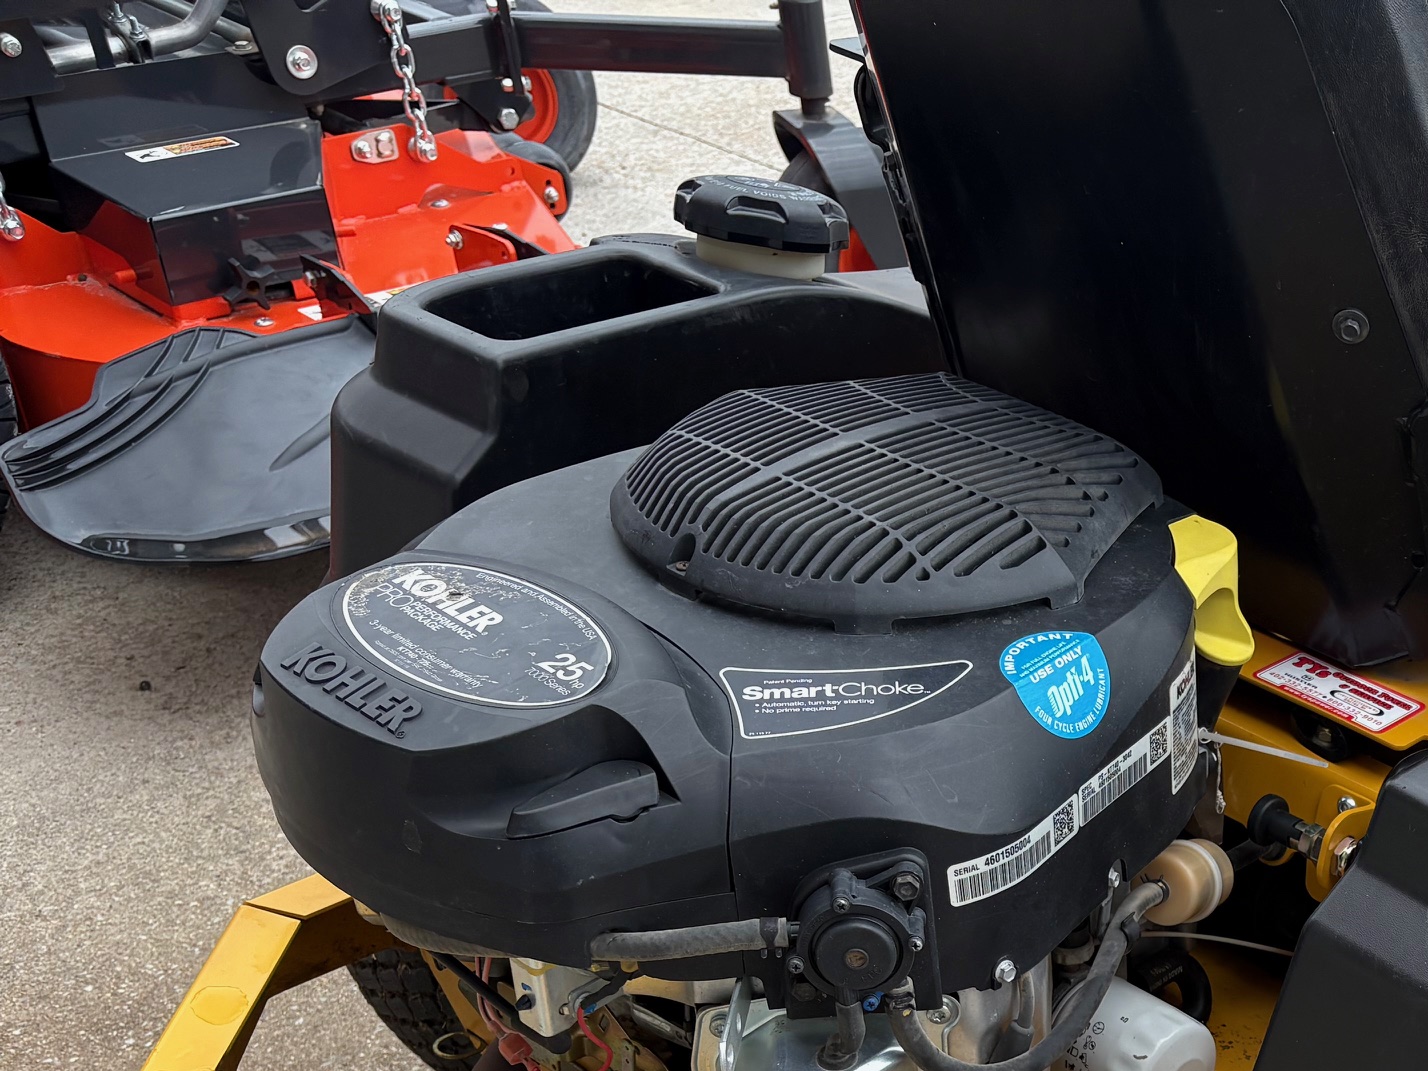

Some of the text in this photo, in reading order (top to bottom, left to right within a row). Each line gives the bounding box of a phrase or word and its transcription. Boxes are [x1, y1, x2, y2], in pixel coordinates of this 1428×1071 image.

[374, 582, 414, 607] PRO
[392, 569, 504, 633] KOHLER
[475, 572, 521, 591] Engineered
[520, 588, 539, 598] and
[538, 591, 572, 617] Assembled
[573, 617, 587, 630] the
[582, 627, 598, 640] USA
[400, 605, 444, 632] PACKAGE
[410, 601, 478, 640] PERFORMANCE
[369, 619, 394, 636] 3-year
[391, 633, 419, 650] limited
[415, 646, 453, 669] consumer
[450, 667, 483, 688] warranty
[537, 653, 594, 681] 25
[1004, 634, 1074, 675] IMPORTANT
[1029, 646, 1083, 683] USE ONLY
[280, 641, 422, 734] KOHLER
[524, 666, 571, 696] 7000 Series
[572, 679, 585, 690] hp
[802, 705, 836, 713] required
[1035, 668, 1105, 733] FOUR CYCLE ENGINE LUBRICANT
[1082, 782, 1092, 793] SPEC
[954, 835, 1031, 877] SERIAL 4601505004
